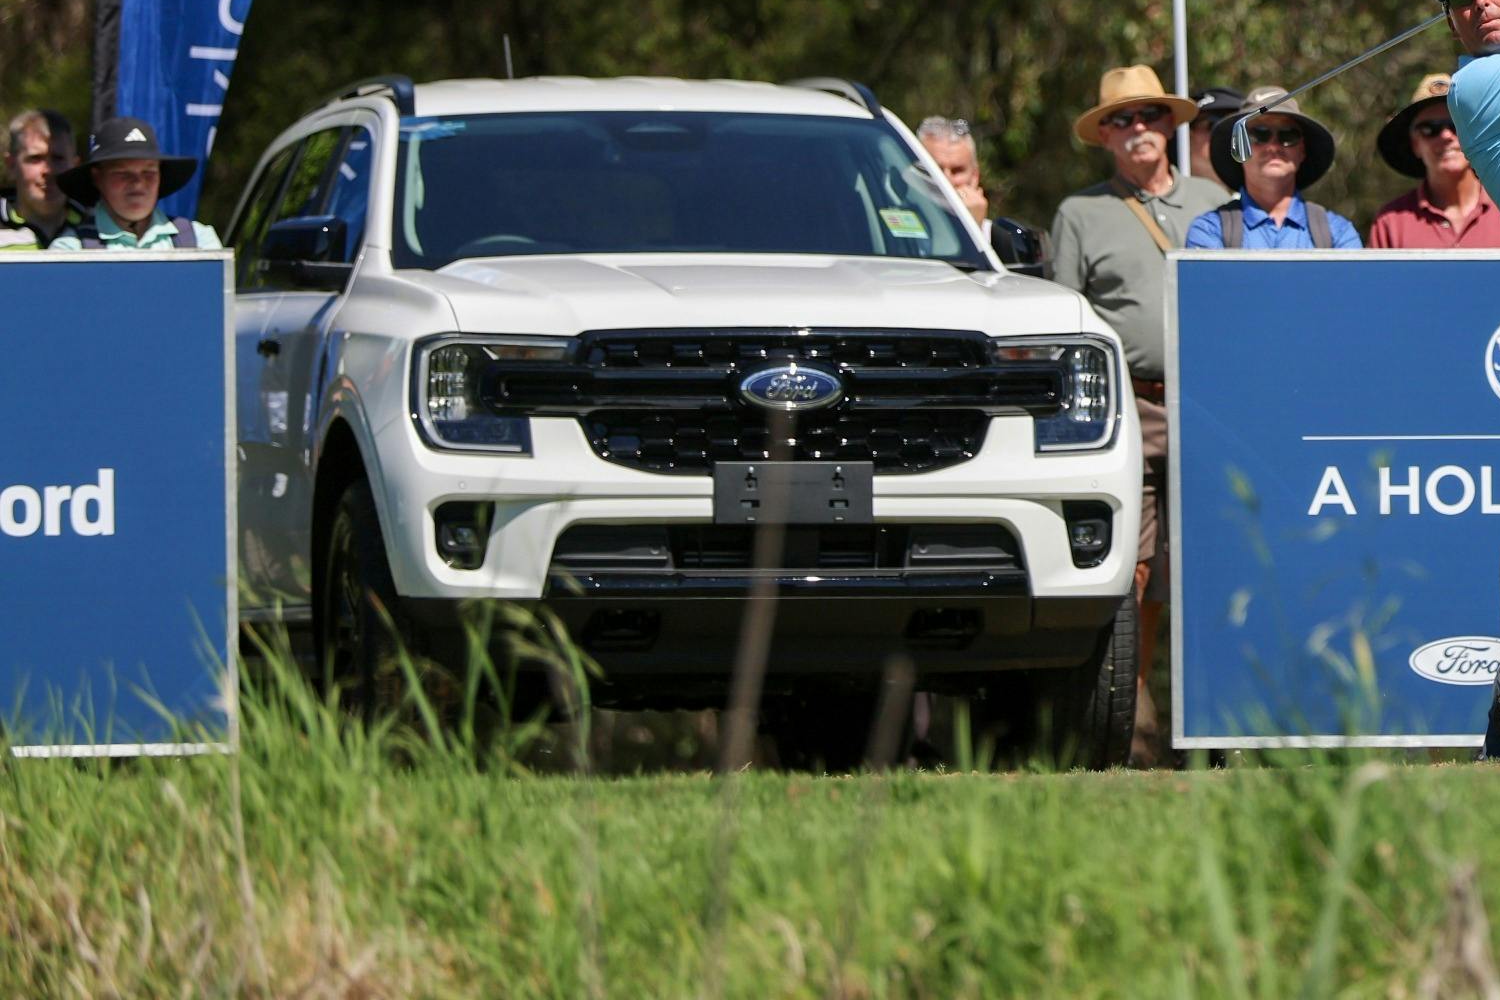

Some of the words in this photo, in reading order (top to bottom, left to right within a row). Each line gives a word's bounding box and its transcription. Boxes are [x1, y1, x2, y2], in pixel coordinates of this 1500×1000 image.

[766, 375, 818, 400] Ford
[0, 468, 115, 537] ord
[1307, 465, 1357, 516] A
